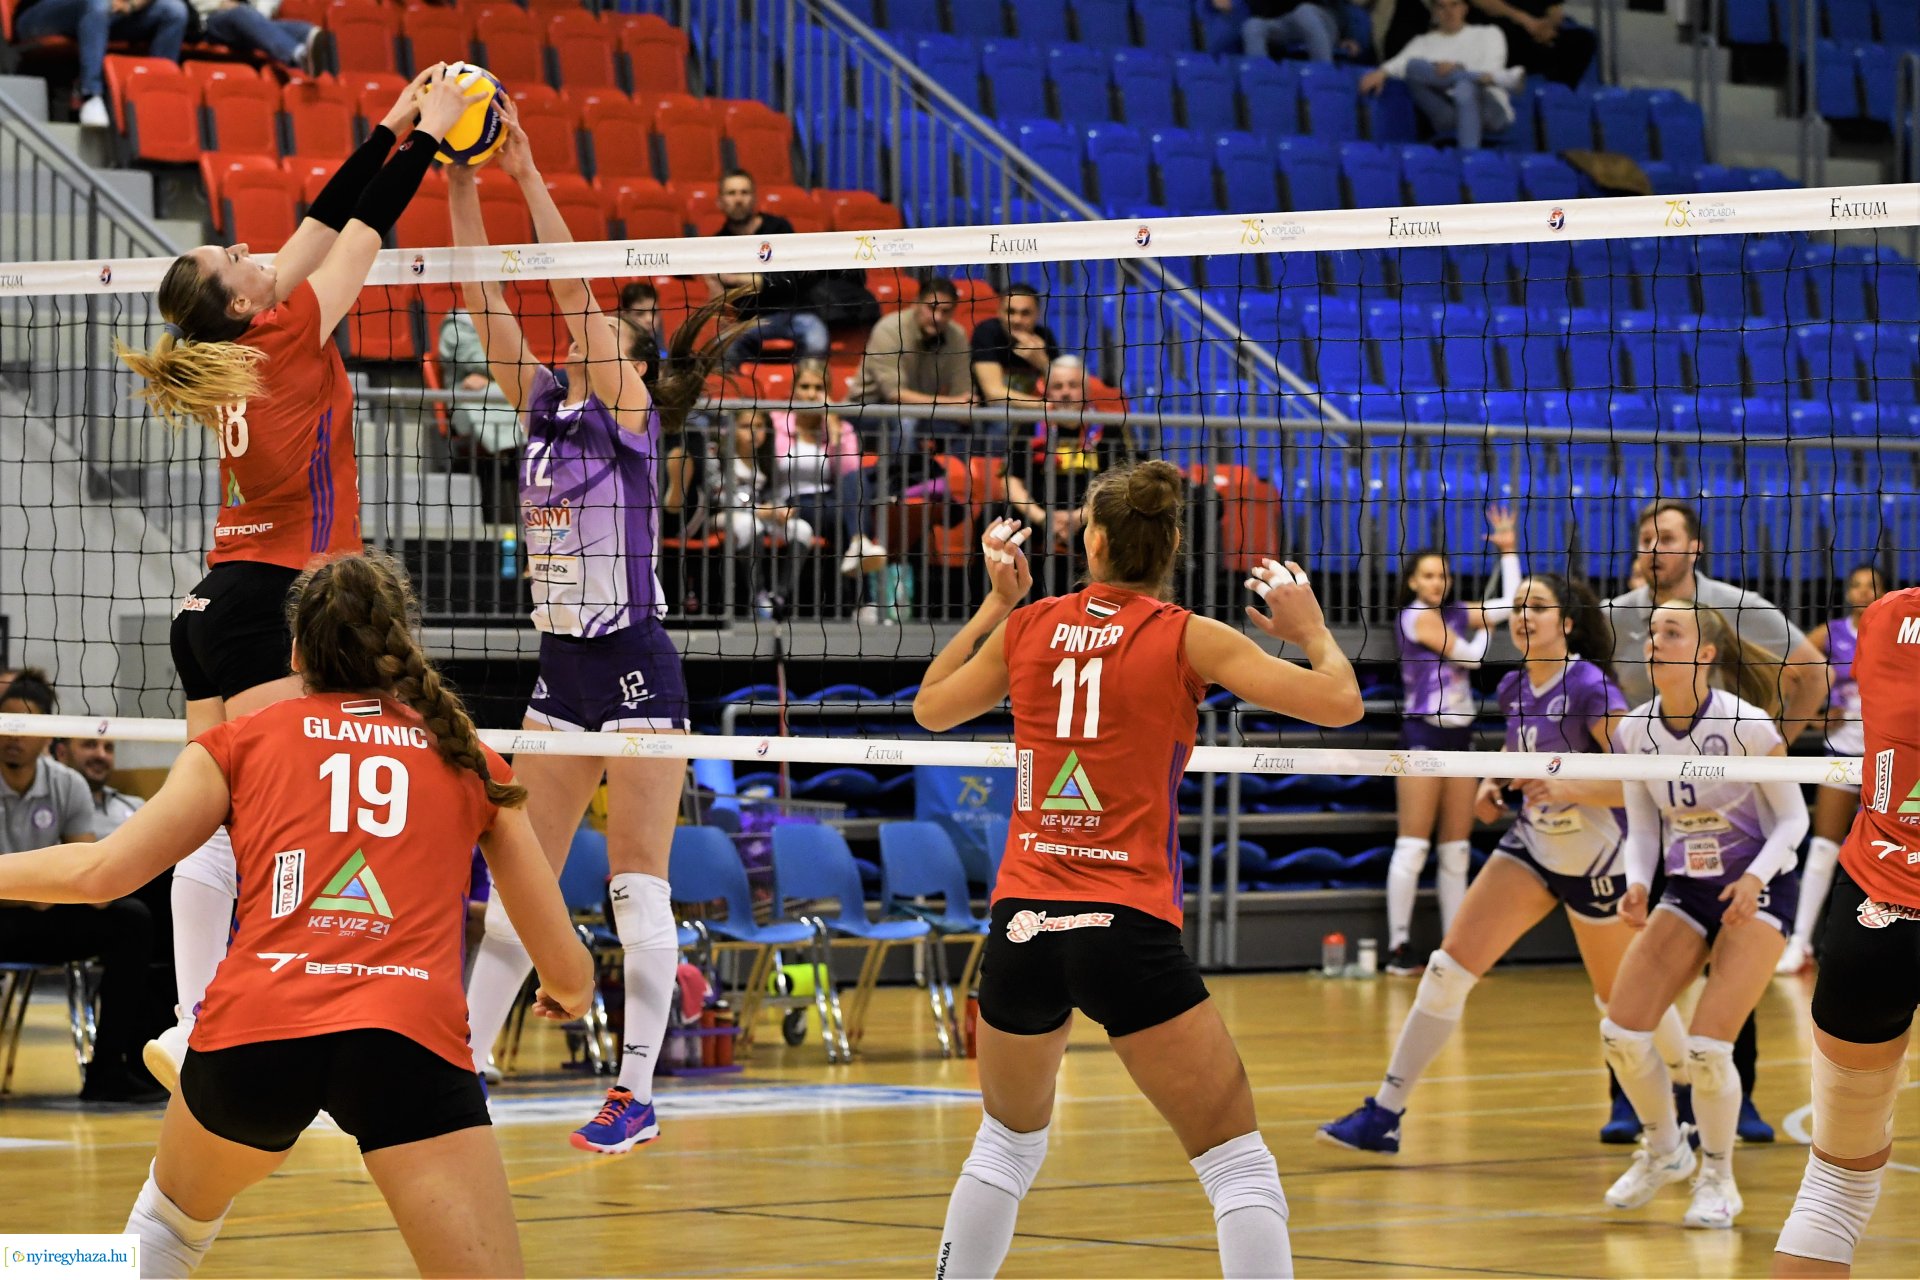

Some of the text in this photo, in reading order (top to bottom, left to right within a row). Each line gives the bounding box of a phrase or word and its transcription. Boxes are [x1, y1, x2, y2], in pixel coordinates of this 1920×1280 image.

[1829, 195, 1888, 217] FATUM
[1388, 216, 1442, 236] FATUM
[989, 233, 1038, 252] FATUM
[626, 248, 669, 266] FATUM
[216, 393, 249, 459] 18
[1050, 623, 1124, 653] PINTÉR
[619, 670, 648, 702] 12
[1052, 657, 1103, 739] 11
[303, 716, 428, 749] GLAVINIC
[511, 735, 546, 750] FATUM
[866, 745, 903, 760] FATUM
[1253, 753, 1295, 769] FATUM
[1680, 761, 1725, 777] FATUM
[1878, 754, 1888, 809] TRABAG
[319, 753, 409, 838] 19
[1668, 781, 1697, 807] 15
[1040, 814, 1101, 827] KE-VIZ 21
[1034, 842, 1129, 862] BESTRONG
[282, 854, 296, 913] STRABAG
[1591, 877, 1615, 897] 10
[307, 915, 391, 936] KE-VIZ 21
[305, 961, 429, 981] BESTRONG
